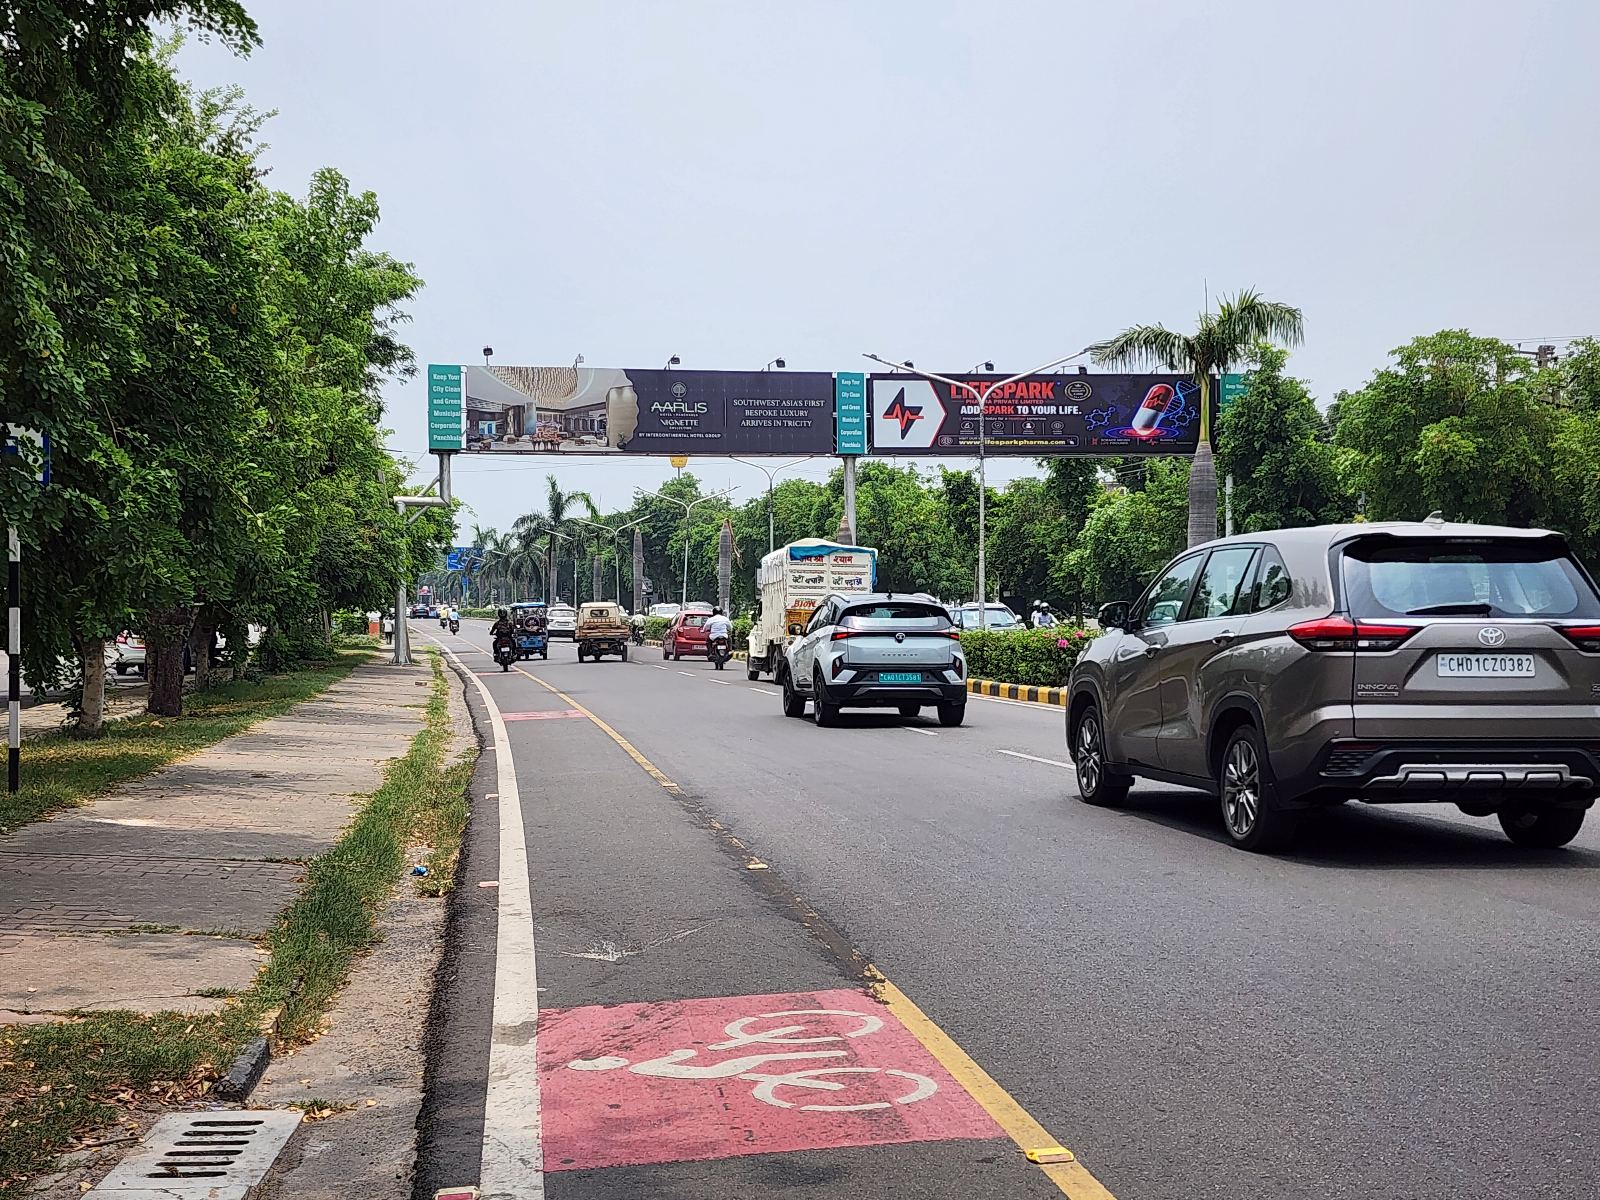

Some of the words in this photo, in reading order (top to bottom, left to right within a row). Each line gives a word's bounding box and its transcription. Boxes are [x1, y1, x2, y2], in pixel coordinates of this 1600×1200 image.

[651, 401, 708, 413] AARLIS
[733, 399, 780, 407] SOUTHWEST
[781, 399, 803, 407] ASIA'S
[960, 405, 980, 415] ADD
[983, 405, 1015, 415] SPARK
[1016, 405, 1027, 415] TO
[1028, 405, 1057, 415] YOUR
[1059, 405, 1082, 415] LIFE.
[1448, 657, 1533, 672] CH01CZ0382
